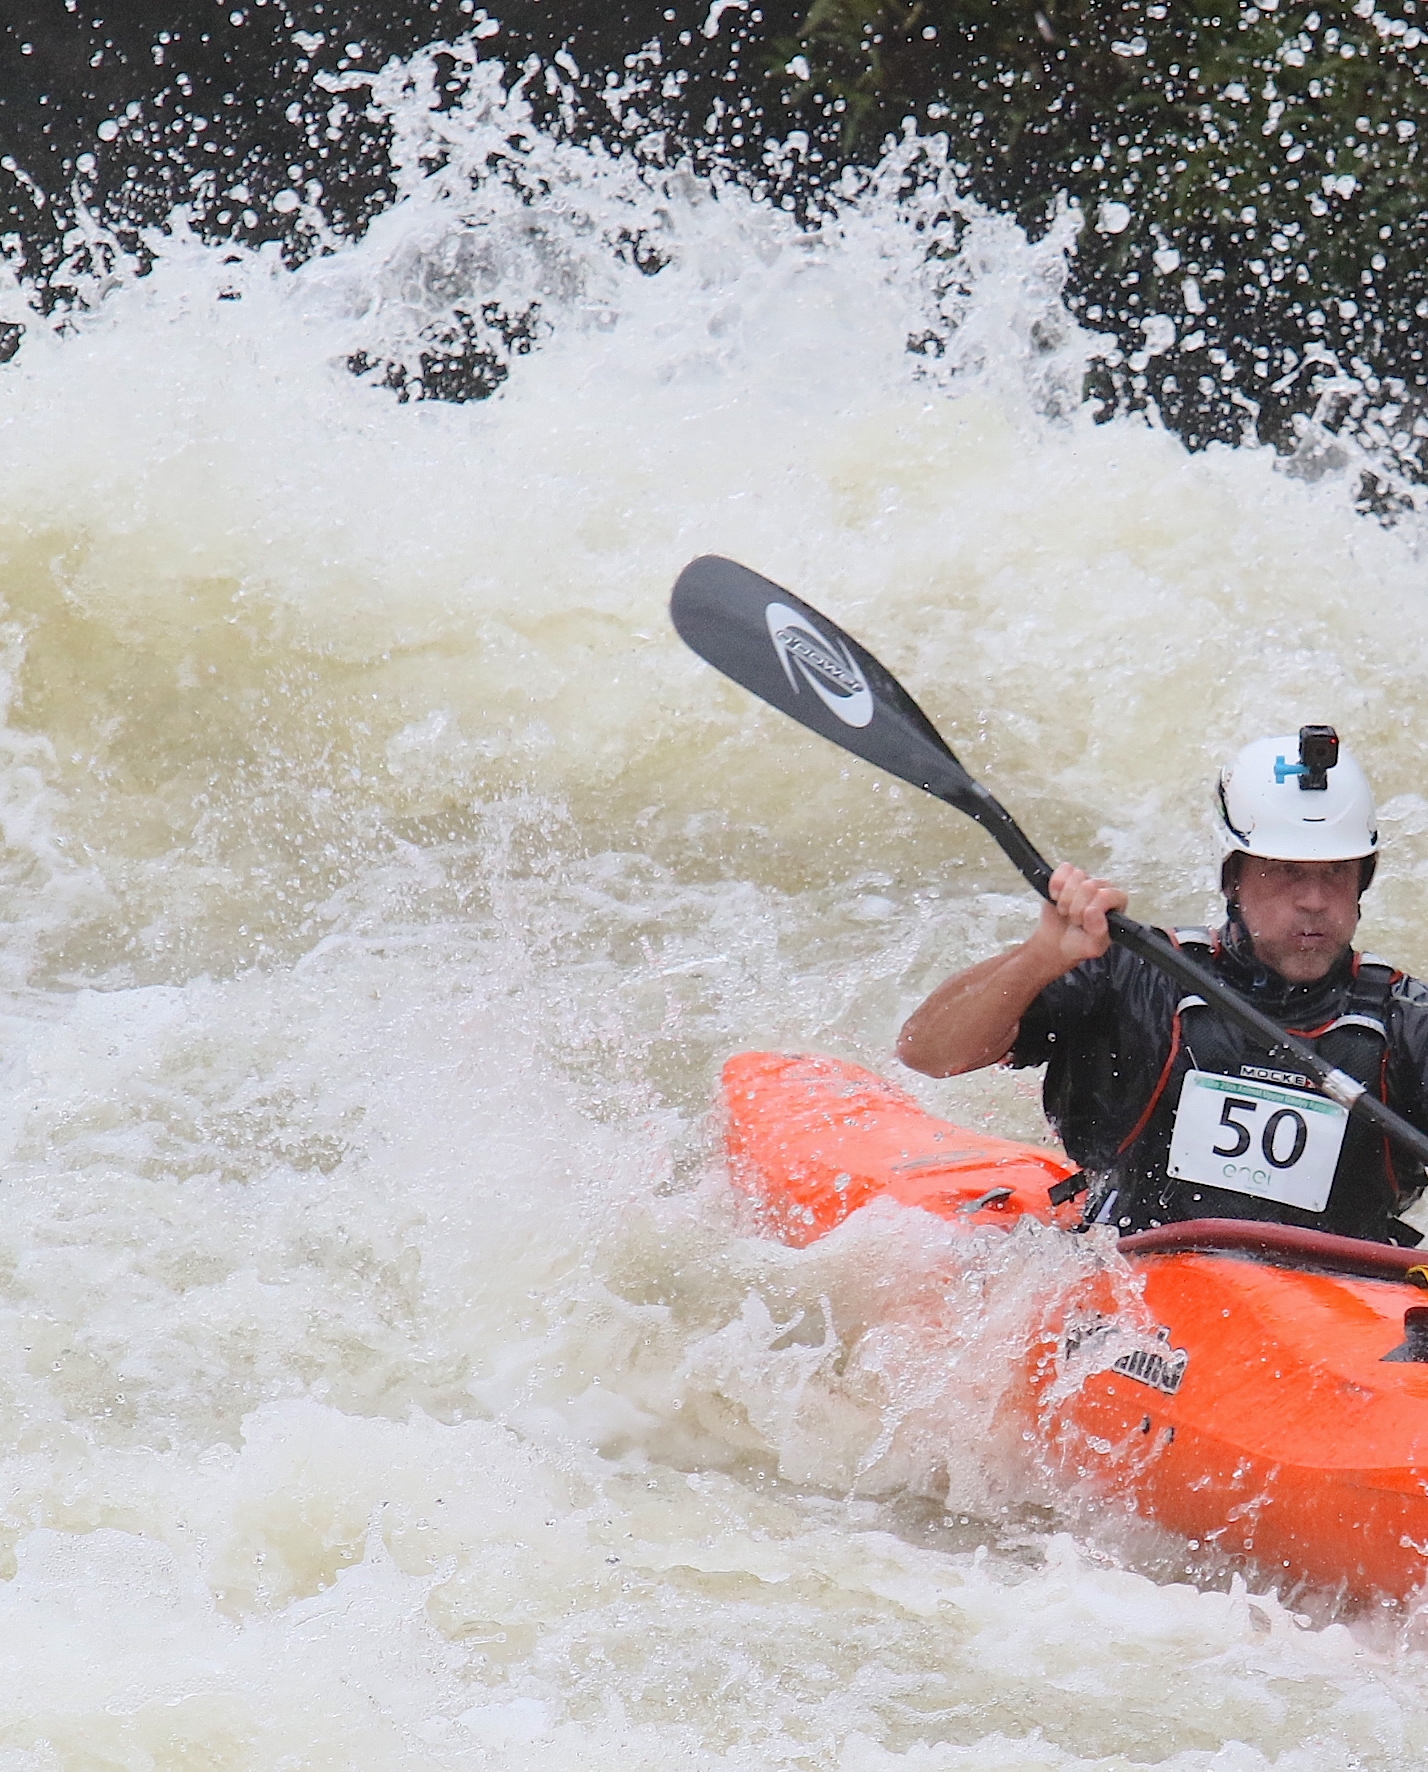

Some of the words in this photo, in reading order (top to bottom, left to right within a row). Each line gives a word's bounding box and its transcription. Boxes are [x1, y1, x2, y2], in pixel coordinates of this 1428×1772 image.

[1241, 1066, 1306, 1086] MOCKE
[1212, 1097, 1308, 1169] 50
[1222, 1163, 1271, 1185] enel
